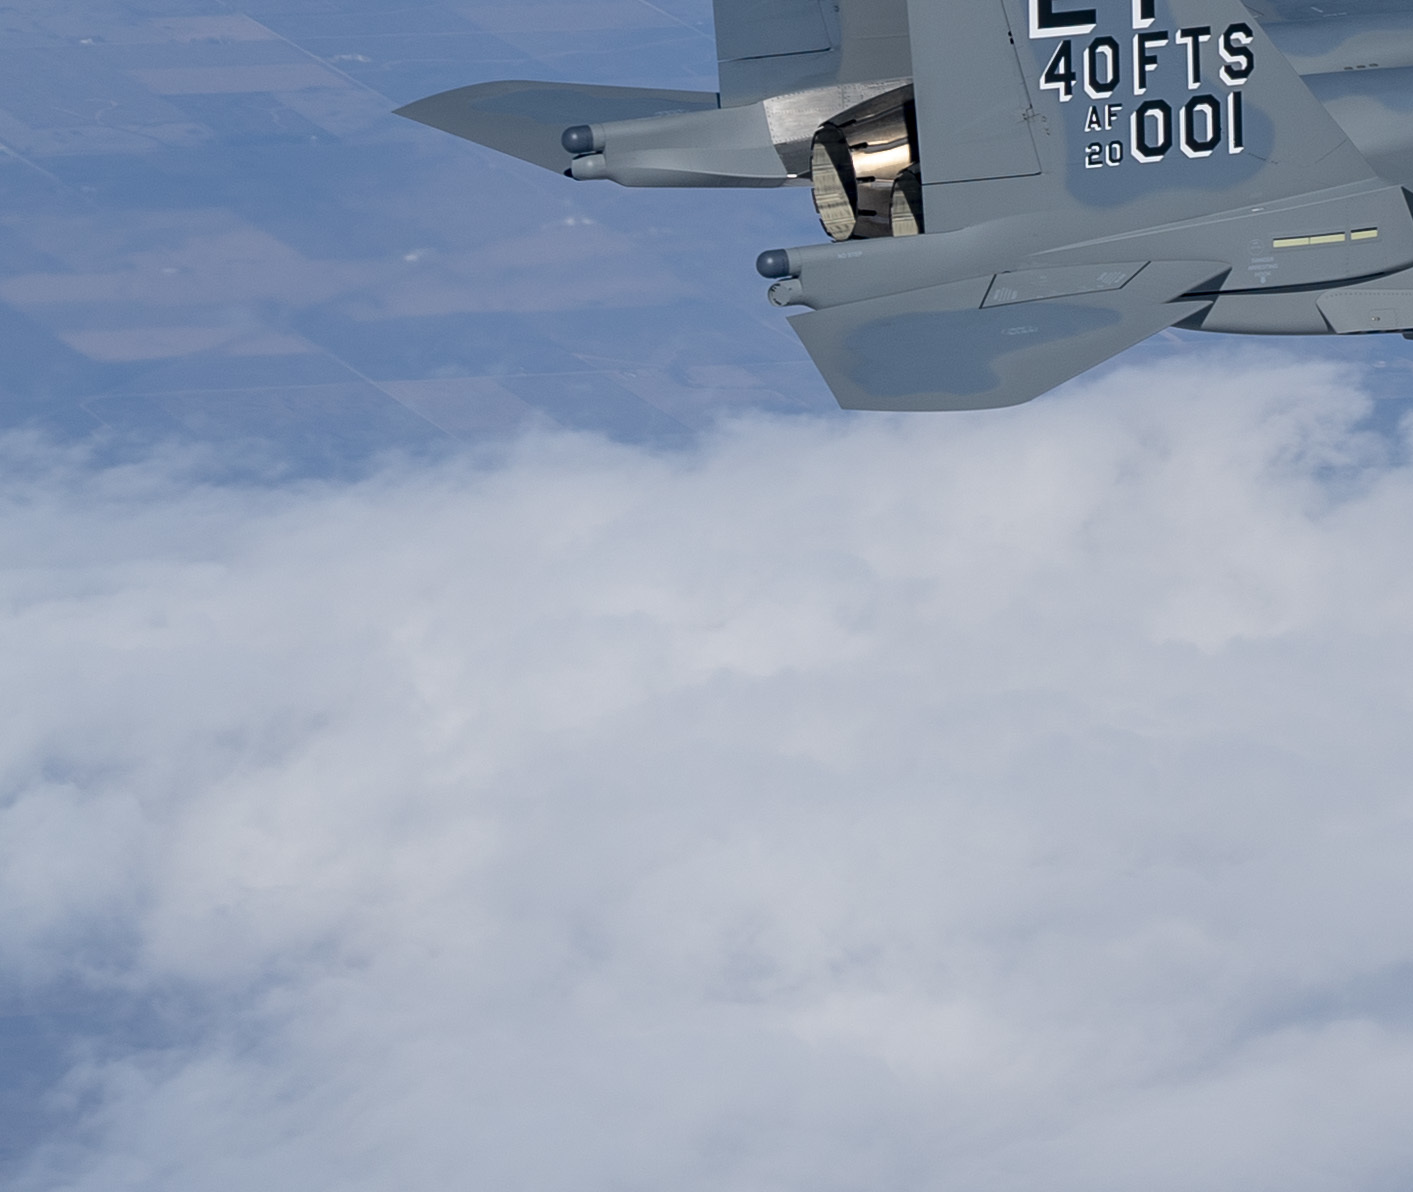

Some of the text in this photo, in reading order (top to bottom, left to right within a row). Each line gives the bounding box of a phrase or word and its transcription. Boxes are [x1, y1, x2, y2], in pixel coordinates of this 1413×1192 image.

[1085, 103, 1123, 132] AF
[1130, 91, 1244, 163] 001
[1085, 140, 1123, 168] 20
